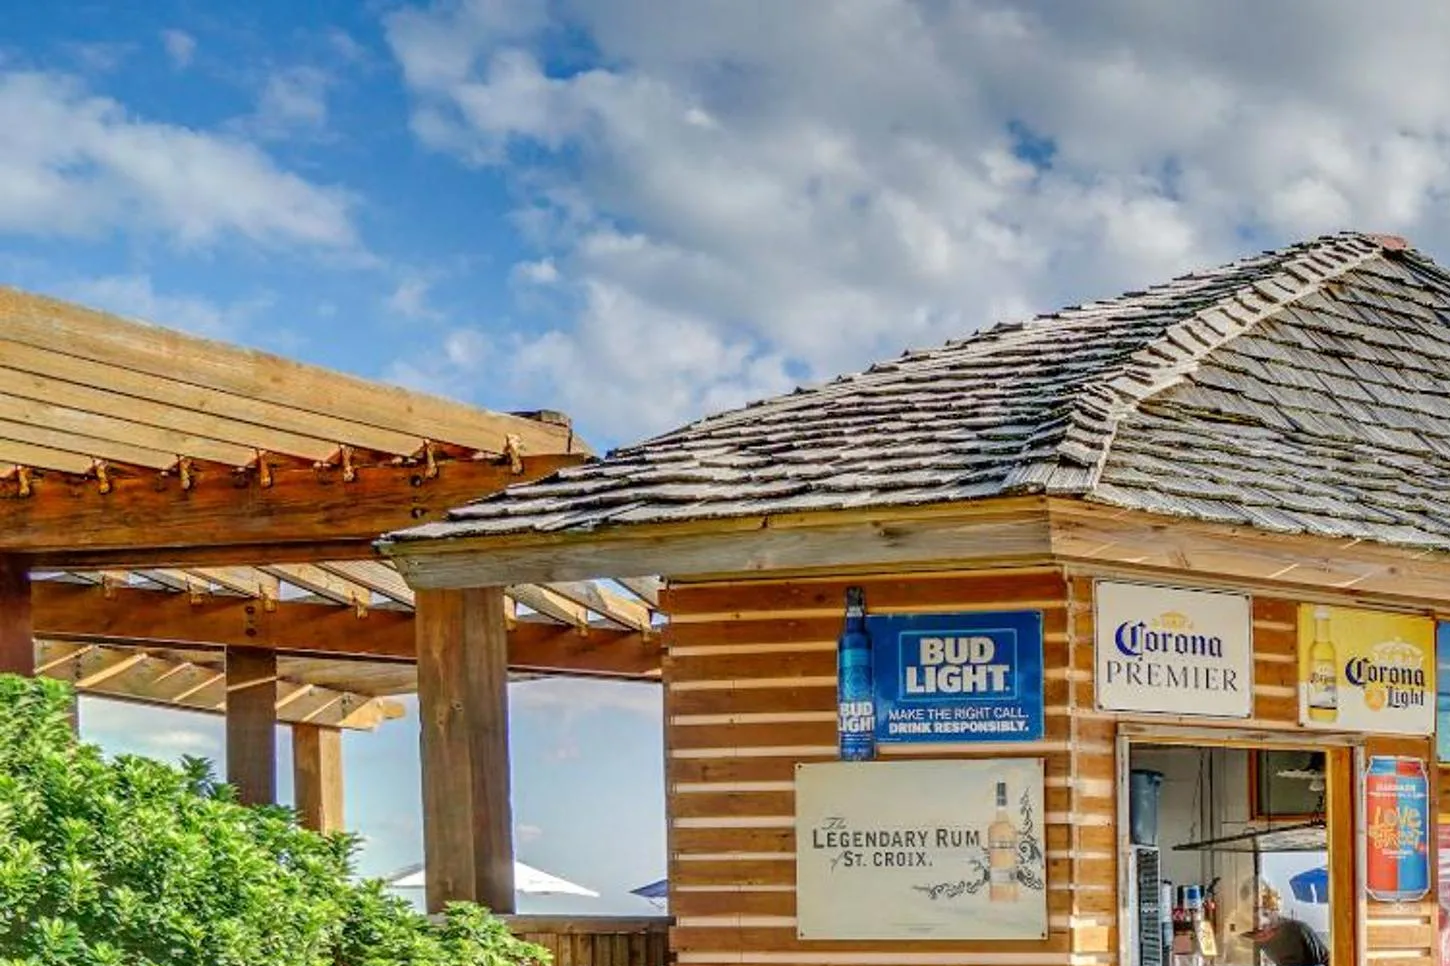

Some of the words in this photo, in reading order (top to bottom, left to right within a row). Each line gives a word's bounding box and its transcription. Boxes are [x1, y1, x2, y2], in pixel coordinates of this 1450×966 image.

[920, 637, 994, 665] BUD
[1115, 620, 1223, 658] Corona
[906, 664, 1010, 693] LIGHT
[1106, 660, 1239, 692] PREMIER
[1345, 656, 1425, 687] Corona
[840, 701, 873, 716] BUD
[1386, 685, 1424, 709] Light
[889, 709, 924, 719] MAKE
[927, 708, 951, 719] THE
[954, 707, 989, 719] RIGHT
[993, 706, 1029, 718] CALL.
[889, 722, 931, 734] DRINK
[934, 721, 1029, 733] RESPONSIBLY.
[813, 829, 928, 849] LEGENDARY
[936, 829, 980, 847] RUM
[873, 850, 933, 867] CROIX.
